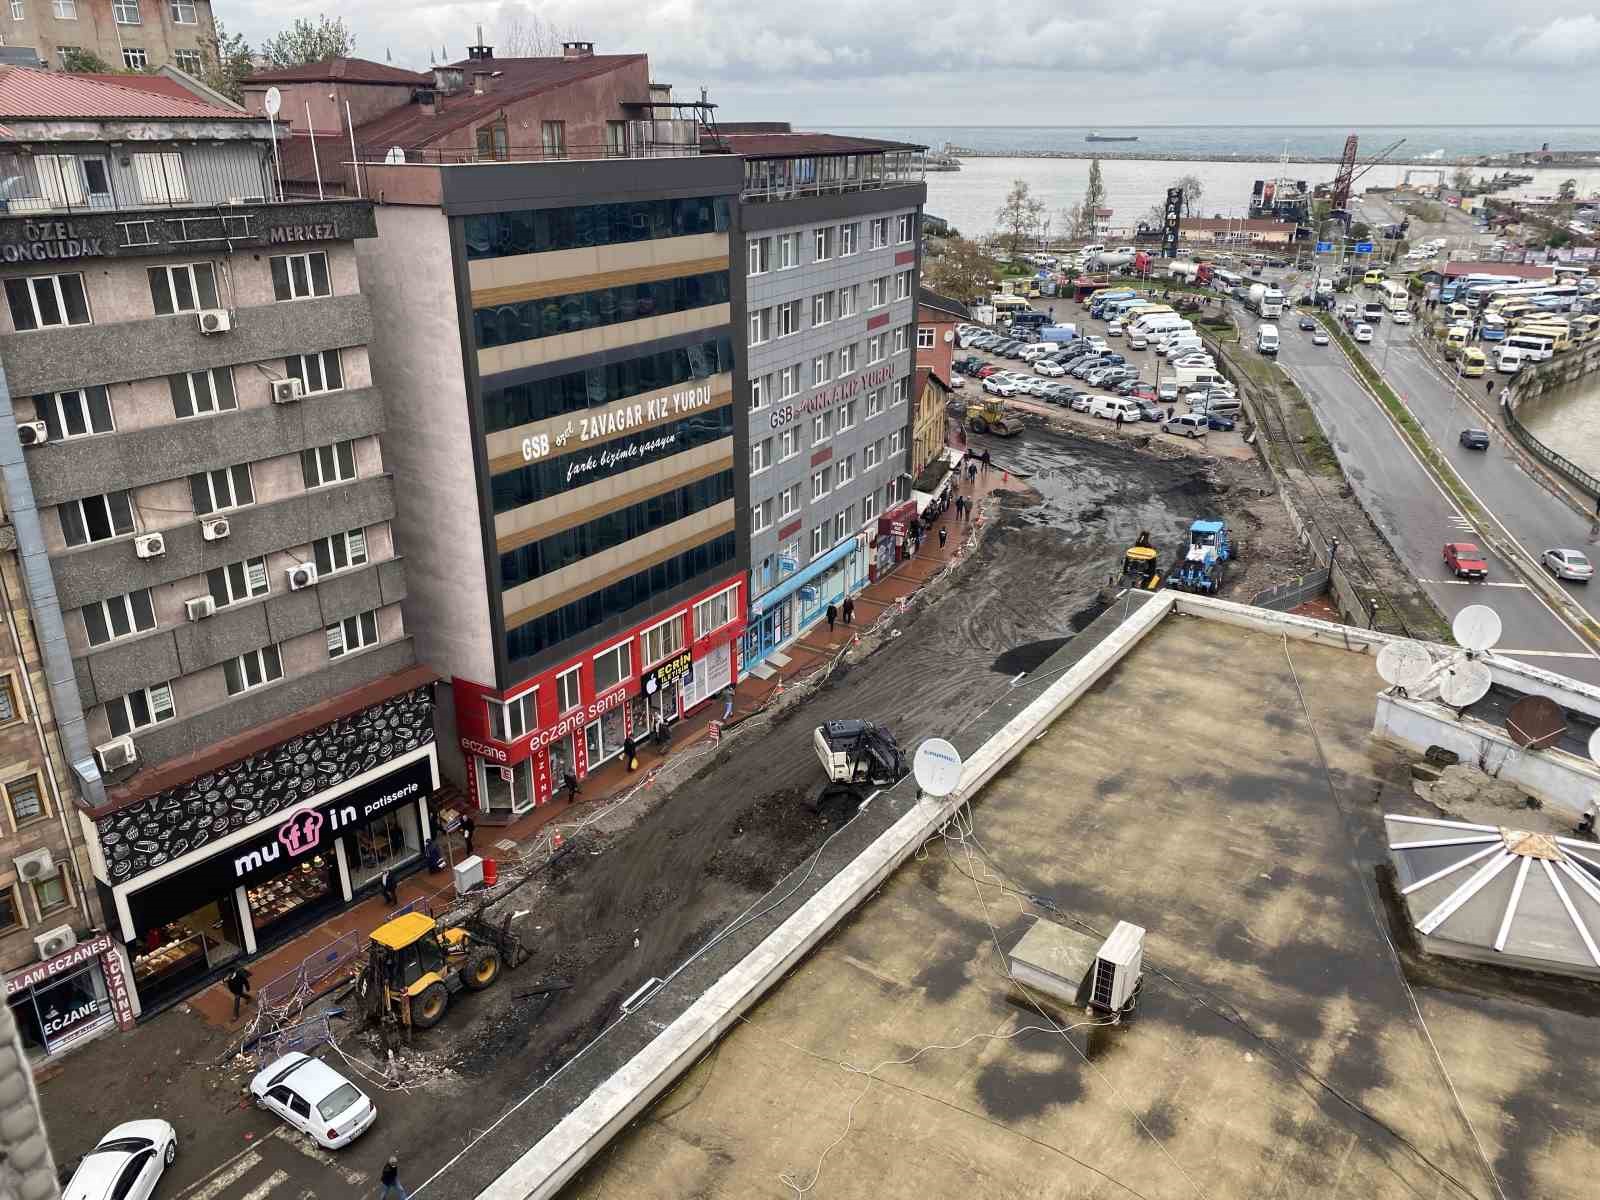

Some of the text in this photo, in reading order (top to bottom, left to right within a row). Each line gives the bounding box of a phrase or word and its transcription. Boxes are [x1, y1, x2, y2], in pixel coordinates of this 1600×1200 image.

[25, 219, 79, 241] ÖZEL
[0, 238, 104, 262] ONGULDAK
[522, 432, 550, 461] GSB
[579, 403, 643, 442] ZAVAGAR
[648, 397, 669, 421] KIZ
[673, 384, 712, 414] YURDU
[770, 405, 793, 429] GSB
[530, 687, 626, 751] eczane sema
[461, 738, 507, 762] eczane
[364, 783, 419, 817] patisserie
[106, 950, 132, 1023] ECZANE
[43, 1000, 98, 1036] ECZANE
